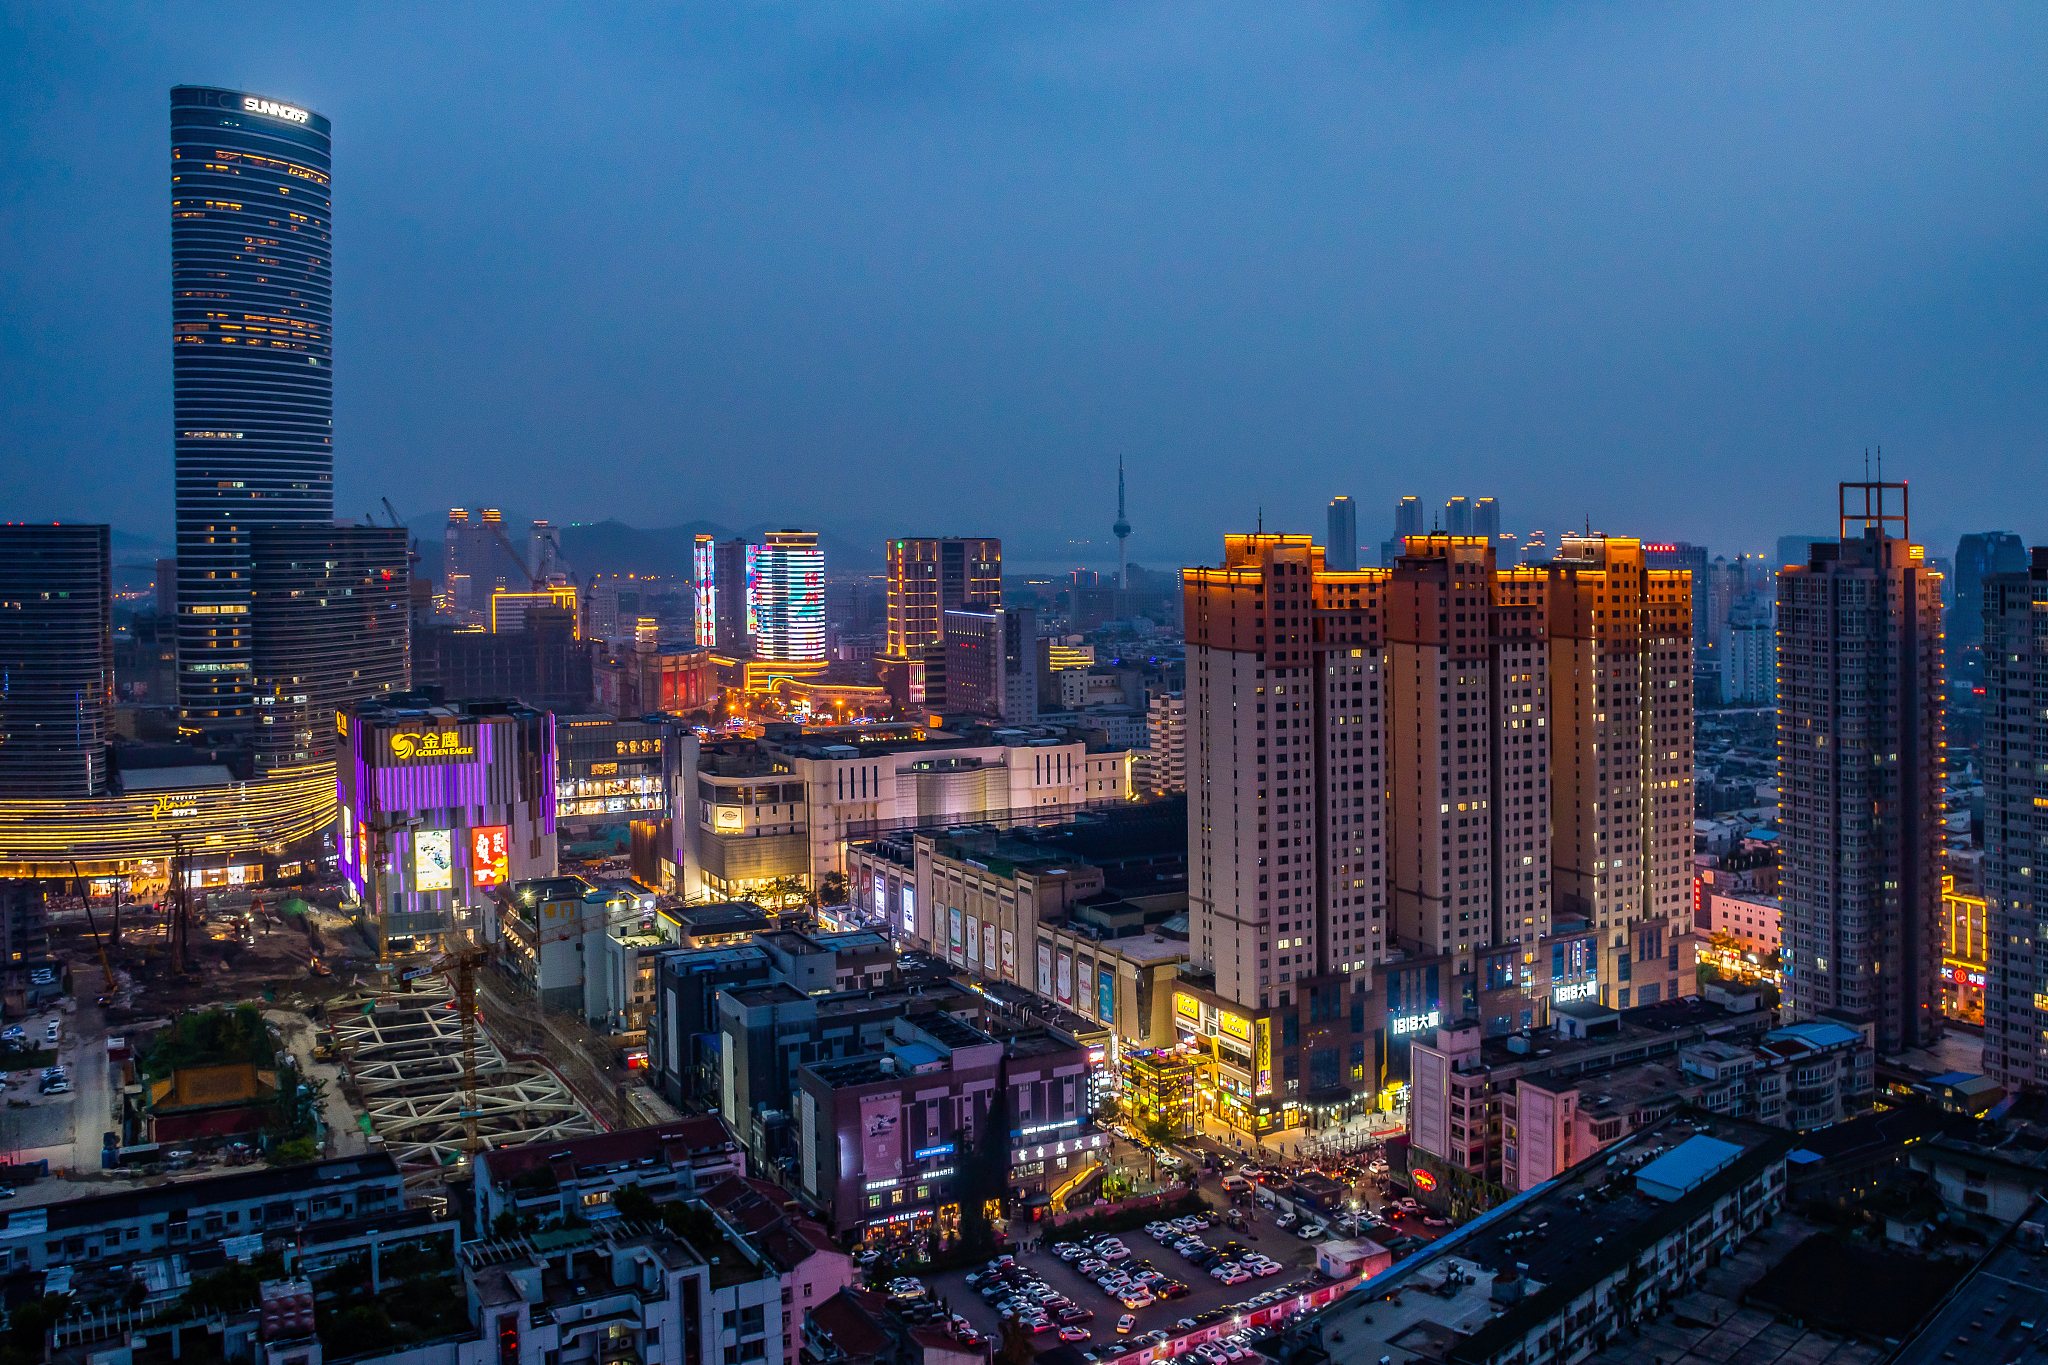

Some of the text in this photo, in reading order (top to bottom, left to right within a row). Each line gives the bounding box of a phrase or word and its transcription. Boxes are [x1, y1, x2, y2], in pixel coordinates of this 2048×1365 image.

[422, 731, 459, 749] 金鹰
[415, 747, 474, 757] GOLDEN EAGLE
[1393, 1011, 1440, 1035] 1818大厦
